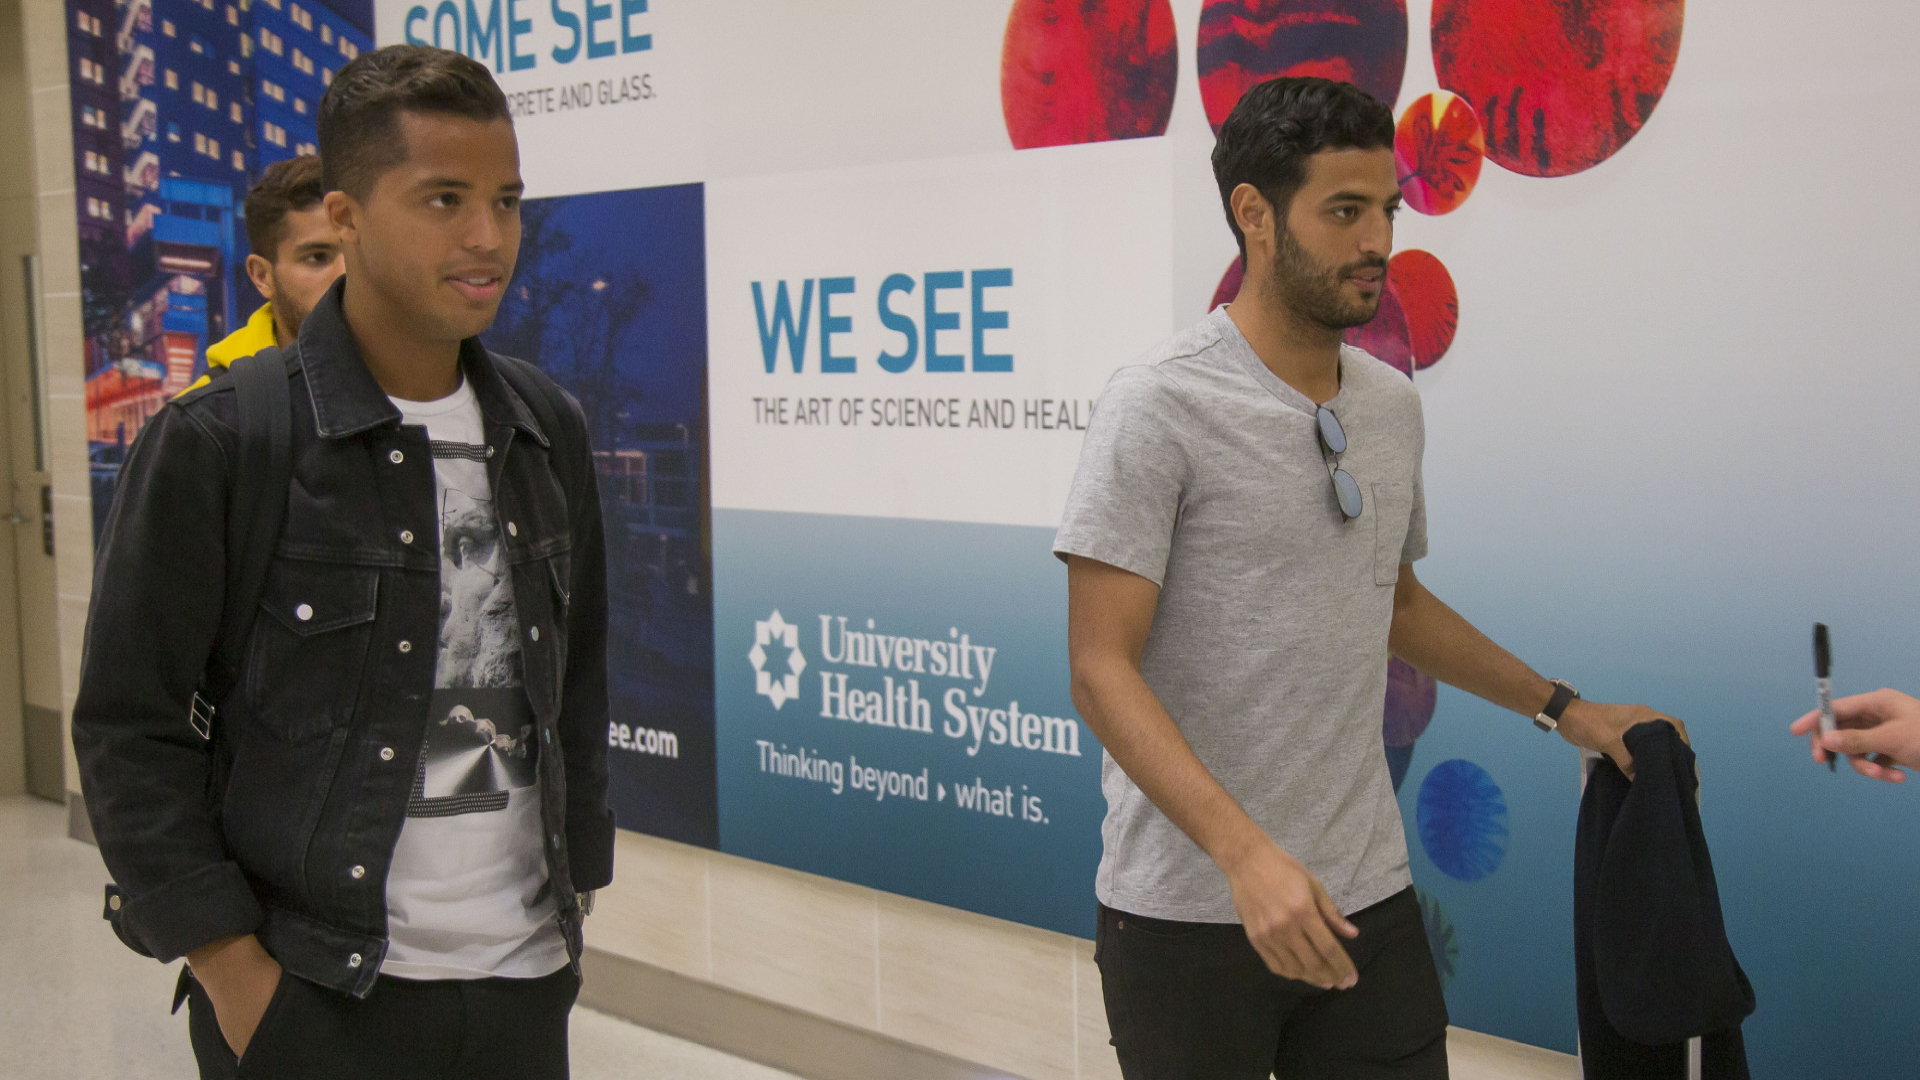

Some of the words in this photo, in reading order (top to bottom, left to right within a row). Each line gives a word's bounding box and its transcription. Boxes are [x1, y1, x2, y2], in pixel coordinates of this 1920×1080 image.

[404, 0, 535, 74] SOME
[551, 0, 653, 64] SEE
[559, 82, 592, 111] AND
[598, 73, 656, 106] GLASS.
[751, 276, 857, 374] WE
[876, 268, 1015, 374] SEE
[753, 397, 789, 425] THE
[794, 397, 832, 425] ART
[839, 397, 864, 426] OF
[870, 398, 961, 428] SCIENCE
[967, 398, 1016, 429] AND
[818, 614, 998, 698] University
[819, 671, 934, 734] Health
[943, 688, 1082, 757] System
[756, 739, 844, 795] Thinking
[849, 756, 929, 802] beyond
[954, 777, 1015, 818] what
[1021, 784, 1050, 824] is.
